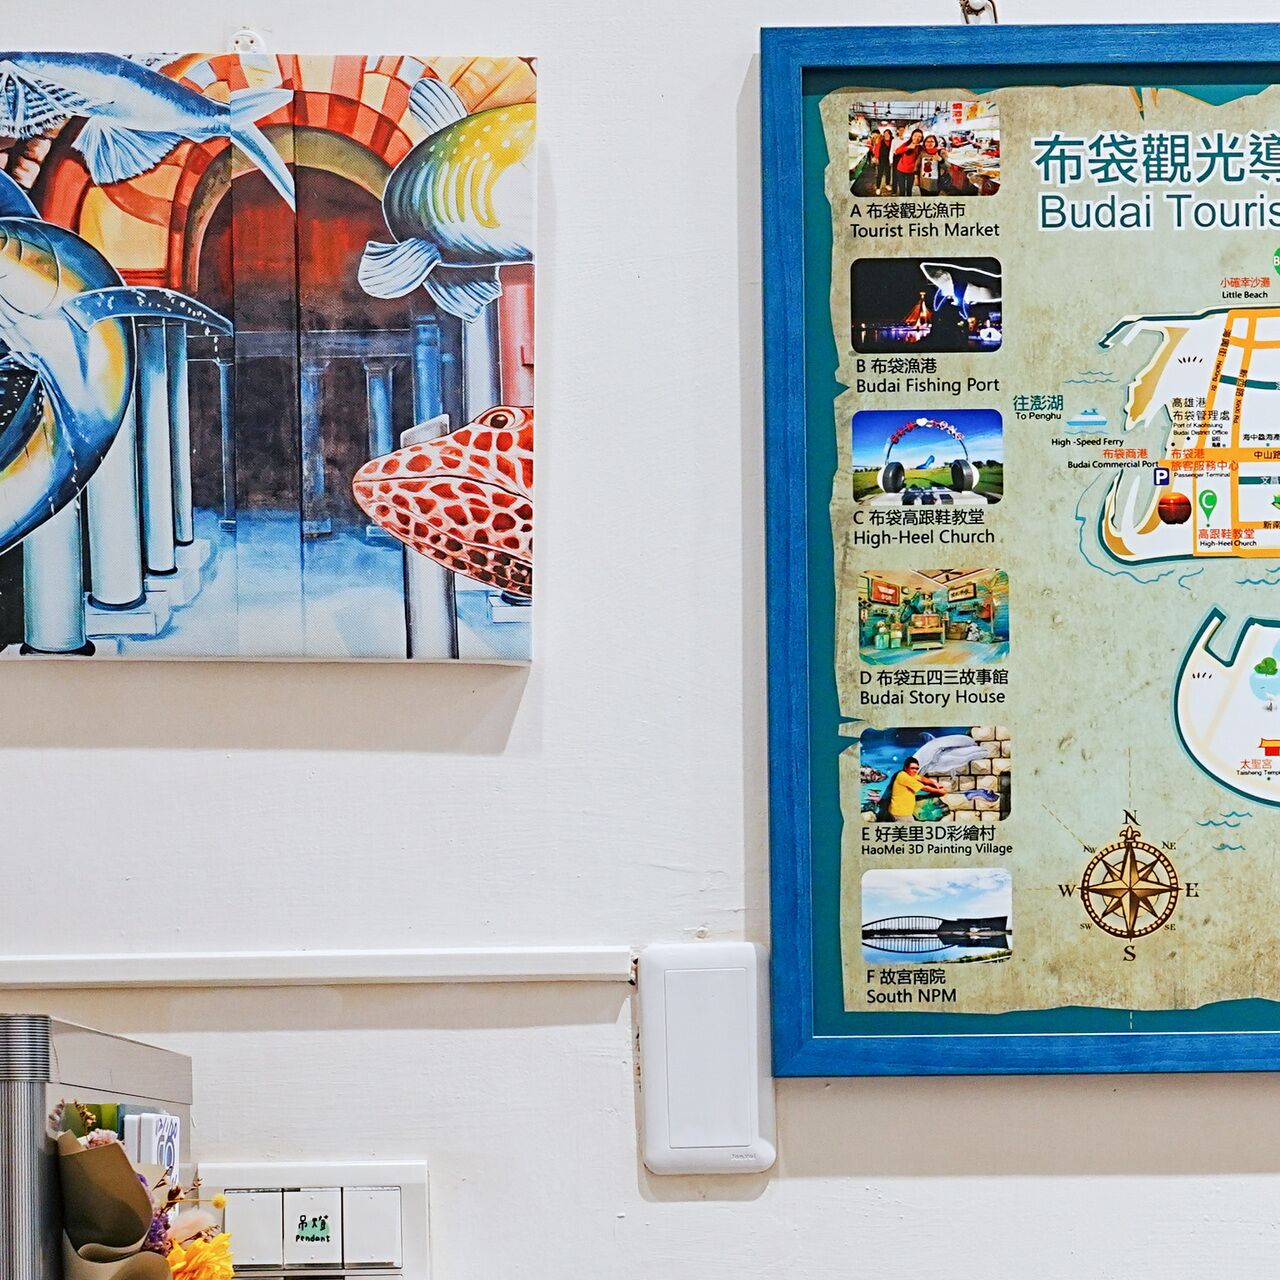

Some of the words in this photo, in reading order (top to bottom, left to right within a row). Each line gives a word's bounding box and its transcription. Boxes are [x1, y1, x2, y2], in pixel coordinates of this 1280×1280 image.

[850, 205, 862, 218] A
[866, 203, 965, 219] 布袋觀光漁市
[1041, 194, 1151, 228] Budai
[850, 224, 904, 238] Tourist
[909, 223, 940, 237] Fish
[945, 222, 999, 237] Market
[1220, 277, 1270, 288] 小確幸沙灘
[1222, 291, 1242, 299] Little
[1244, 291, 1268, 299] Beach
[856, 360, 866, 373] B
[872, 358, 937, 374] 布袋漁港
[856, 379, 900, 394] Budai
[906, 379, 962, 396] Fishing
[967, 378, 1000, 392] Port
[1013, 395, 1063, 411] 往澎湖
[1015, 412, 1026, 420] To
[1029, 411, 1062, 421] Penghu
[1103, 448, 1148, 459] 布袋商港
[1068, 461, 1090, 469] Budai
[1092, 460, 1139, 468] Commercial
[1142, 460, 1159, 468] Port
[854, 511, 864, 525] C
[869, 509, 984, 526] 布袋高跟鞋教堂
[854, 530, 934, 548] High-Heel
[939, 529, 995, 544] Church
[860, 671, 871, 684] D
[877, 670, 1009, 686] 布袋五四三故事館
[860, 690, 904, 705] Budai
[909, 690, 950, 708] Story
[956, 689, 1005, 704] House
[1123, 810, 1141, 826] N
[862, 827, 871, 841] E
[876, 826, 995, 842] 好美里3D彩繪村
[861, 843, 904, 855] HaoMei
[908, 843, 923, 855] 3D
[927, 843, 972, 857] Painting
[975, 842, 1012, 856] Village
[1059, 885, 1076, 897] W
[1185, 883, 1199, 897] E
[1123, 946, 1136, 961] S
[867, 971, 875, 983] F
[880, 968, 946, 985] 故宮南院
[867, 988, 913, 1003] South
[918, 989, 957, 1003] NPM
